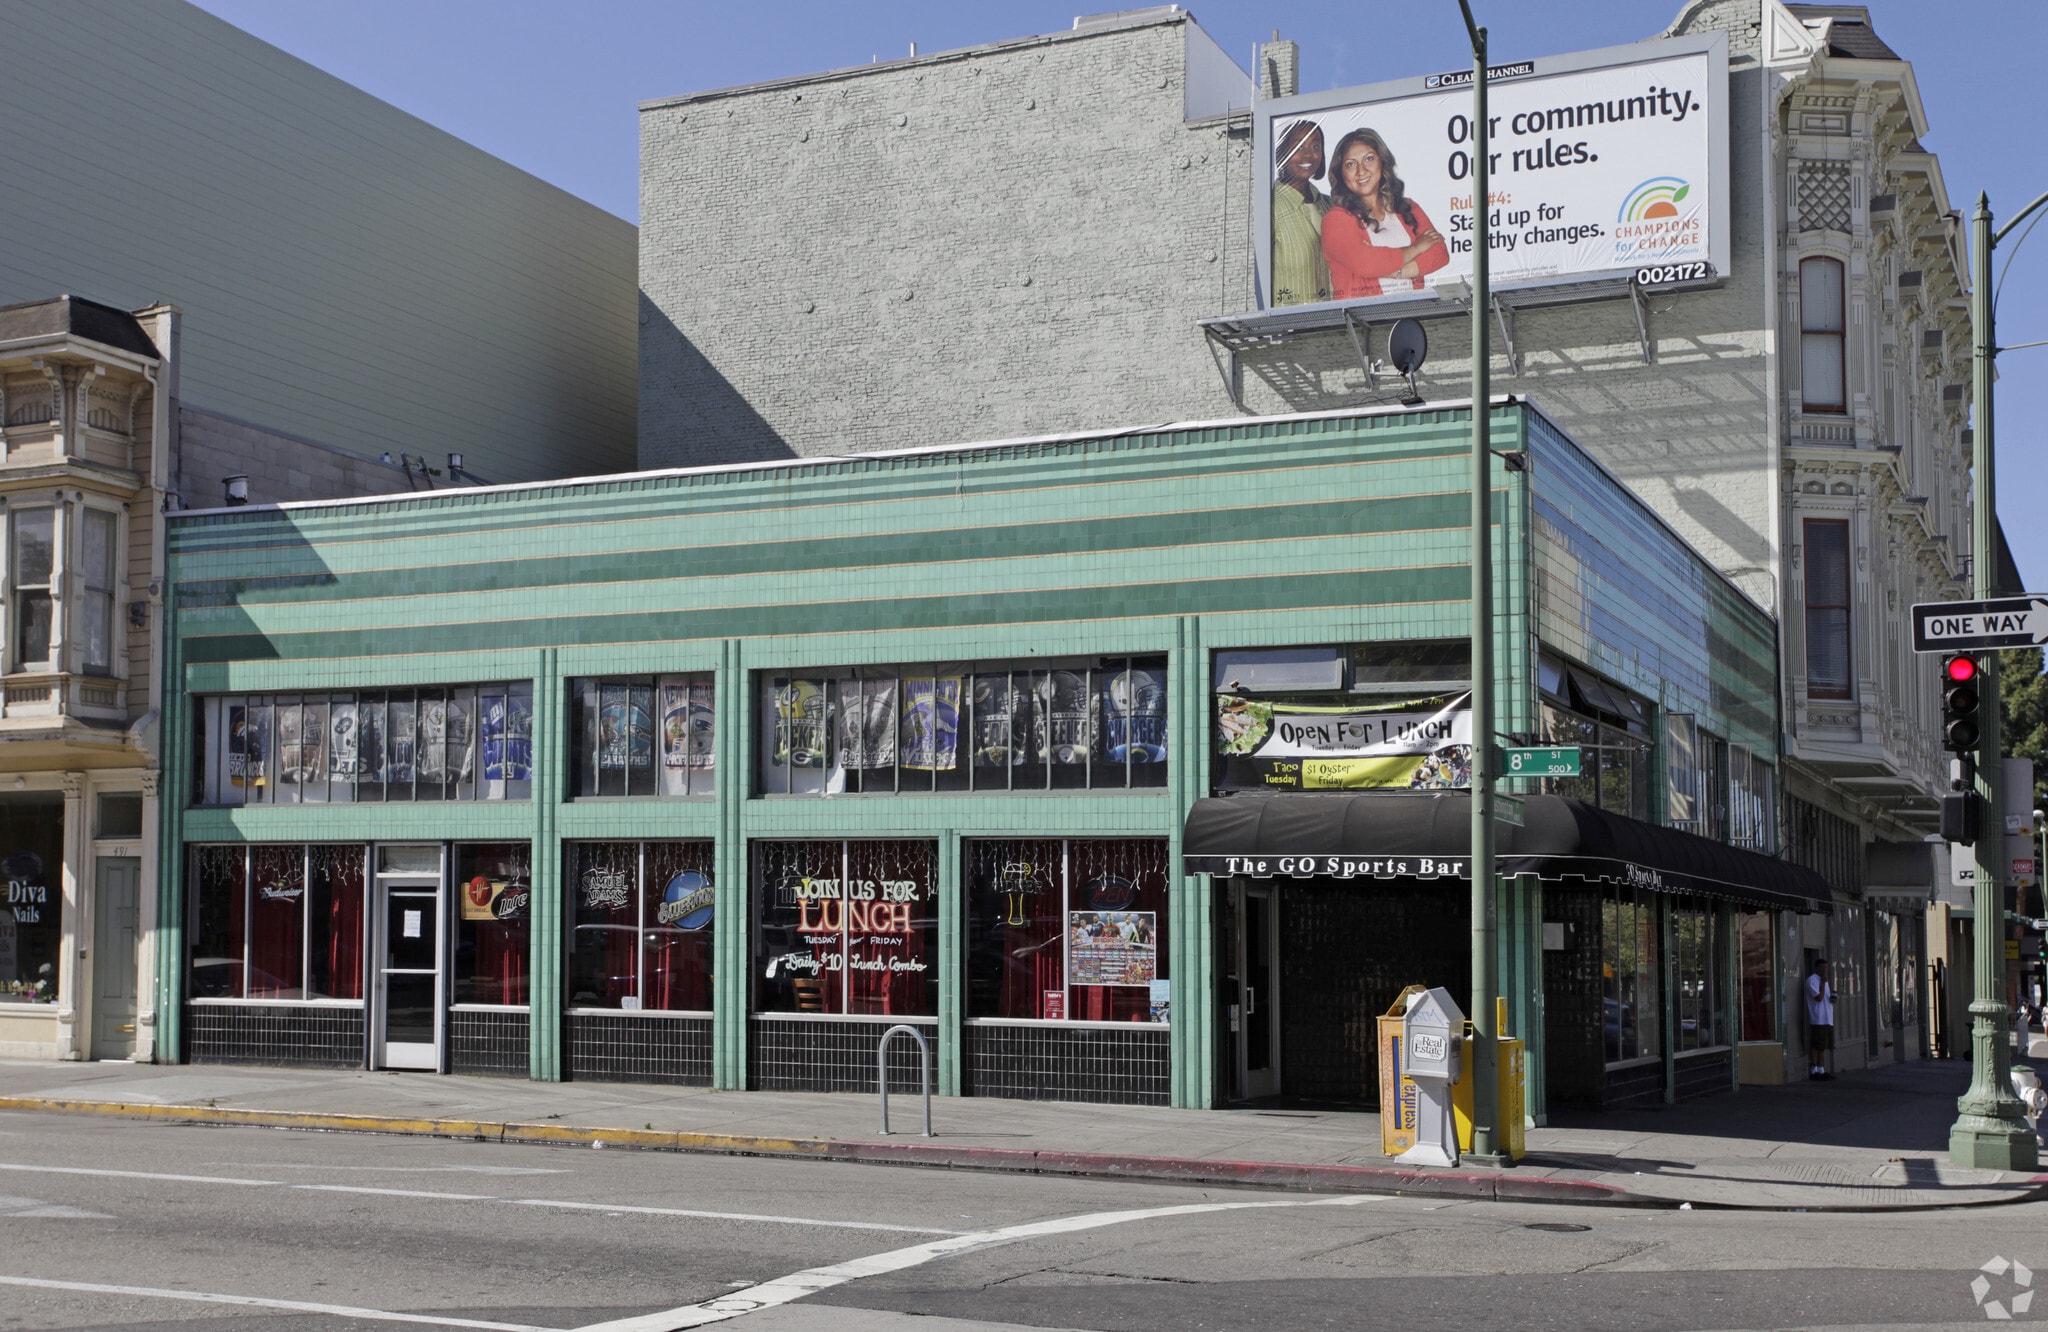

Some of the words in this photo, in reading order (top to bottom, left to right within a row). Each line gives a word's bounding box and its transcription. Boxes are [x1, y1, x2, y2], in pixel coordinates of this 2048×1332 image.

[1487, 64, 1532, 79] HANNEL
[1511, 85, 1700, 136] community.
[1512, 137, 1599, 172] rules.
[1450, 194, 1474, 211] Rul
[1450, 209, 1500, 232] Stad
[1508, 209, 1530, 228] up
[1537, 202, 1565, 222] for
[1615, 218, 1700, 239] CHAMPIONS
[1450, 230, 1518, 254] hethy
[1524, 223, 1605, 245] changes.
[1616, 241, 1634, 253] for
[1638, 232, 1699, 250] CHANGE
[1637, 262, 1706, 285] 002172
[1931, 617, 1974, 636] ONE
[1982, 613, 2028, 633] WAY
[1312, 744, 1335, 752] Tuesday
[1426, 740, 1440, 748] 2pm
[1273, 762, 1299, 773] Taco
[1307, 764, 1316, 775] $1
[1510, 752, 1532, 771] 8th
[1551, 751, 1561, 759] ST
[1548, 764, 1566, 773] 500
[1264, 774, 1297, 785] Tuesday
[1318, 776, 1343, 786] Friday
[1226, 857, 1267, 873] The
[1279, 857, 1316, 873] GO
[1327, 857, 1407, 877] Sports
[1419, 858, 1463, 875] Bar
[8, 880, 47, 903] Diva
[582, 874, 629, 892] SAMUEL
[794, 879, 840, 899] JOIN
[849, 880, 875, 900] US
[881, 880, 919, 901] FOR
[584, 889, 626, 906] ADAMS
[13, 906, 40, 923] Nails
[797, 898, 915, 933] LUNCH
[804, 936, 837, 945] TUESDAY
[870, 936, 903, 945] FRIDAY
[785, 953, 822, 976] Daily
[821, 952, 843, 971] $10
[850, 953, 887, 971] Lunch
[888, 954, 927, 972] Combo
[1415, 1043, 1443, 1056] Estate
[1422, 1036, 1443, 1048] Real
[1400, 1085, 1417, 1130] express
